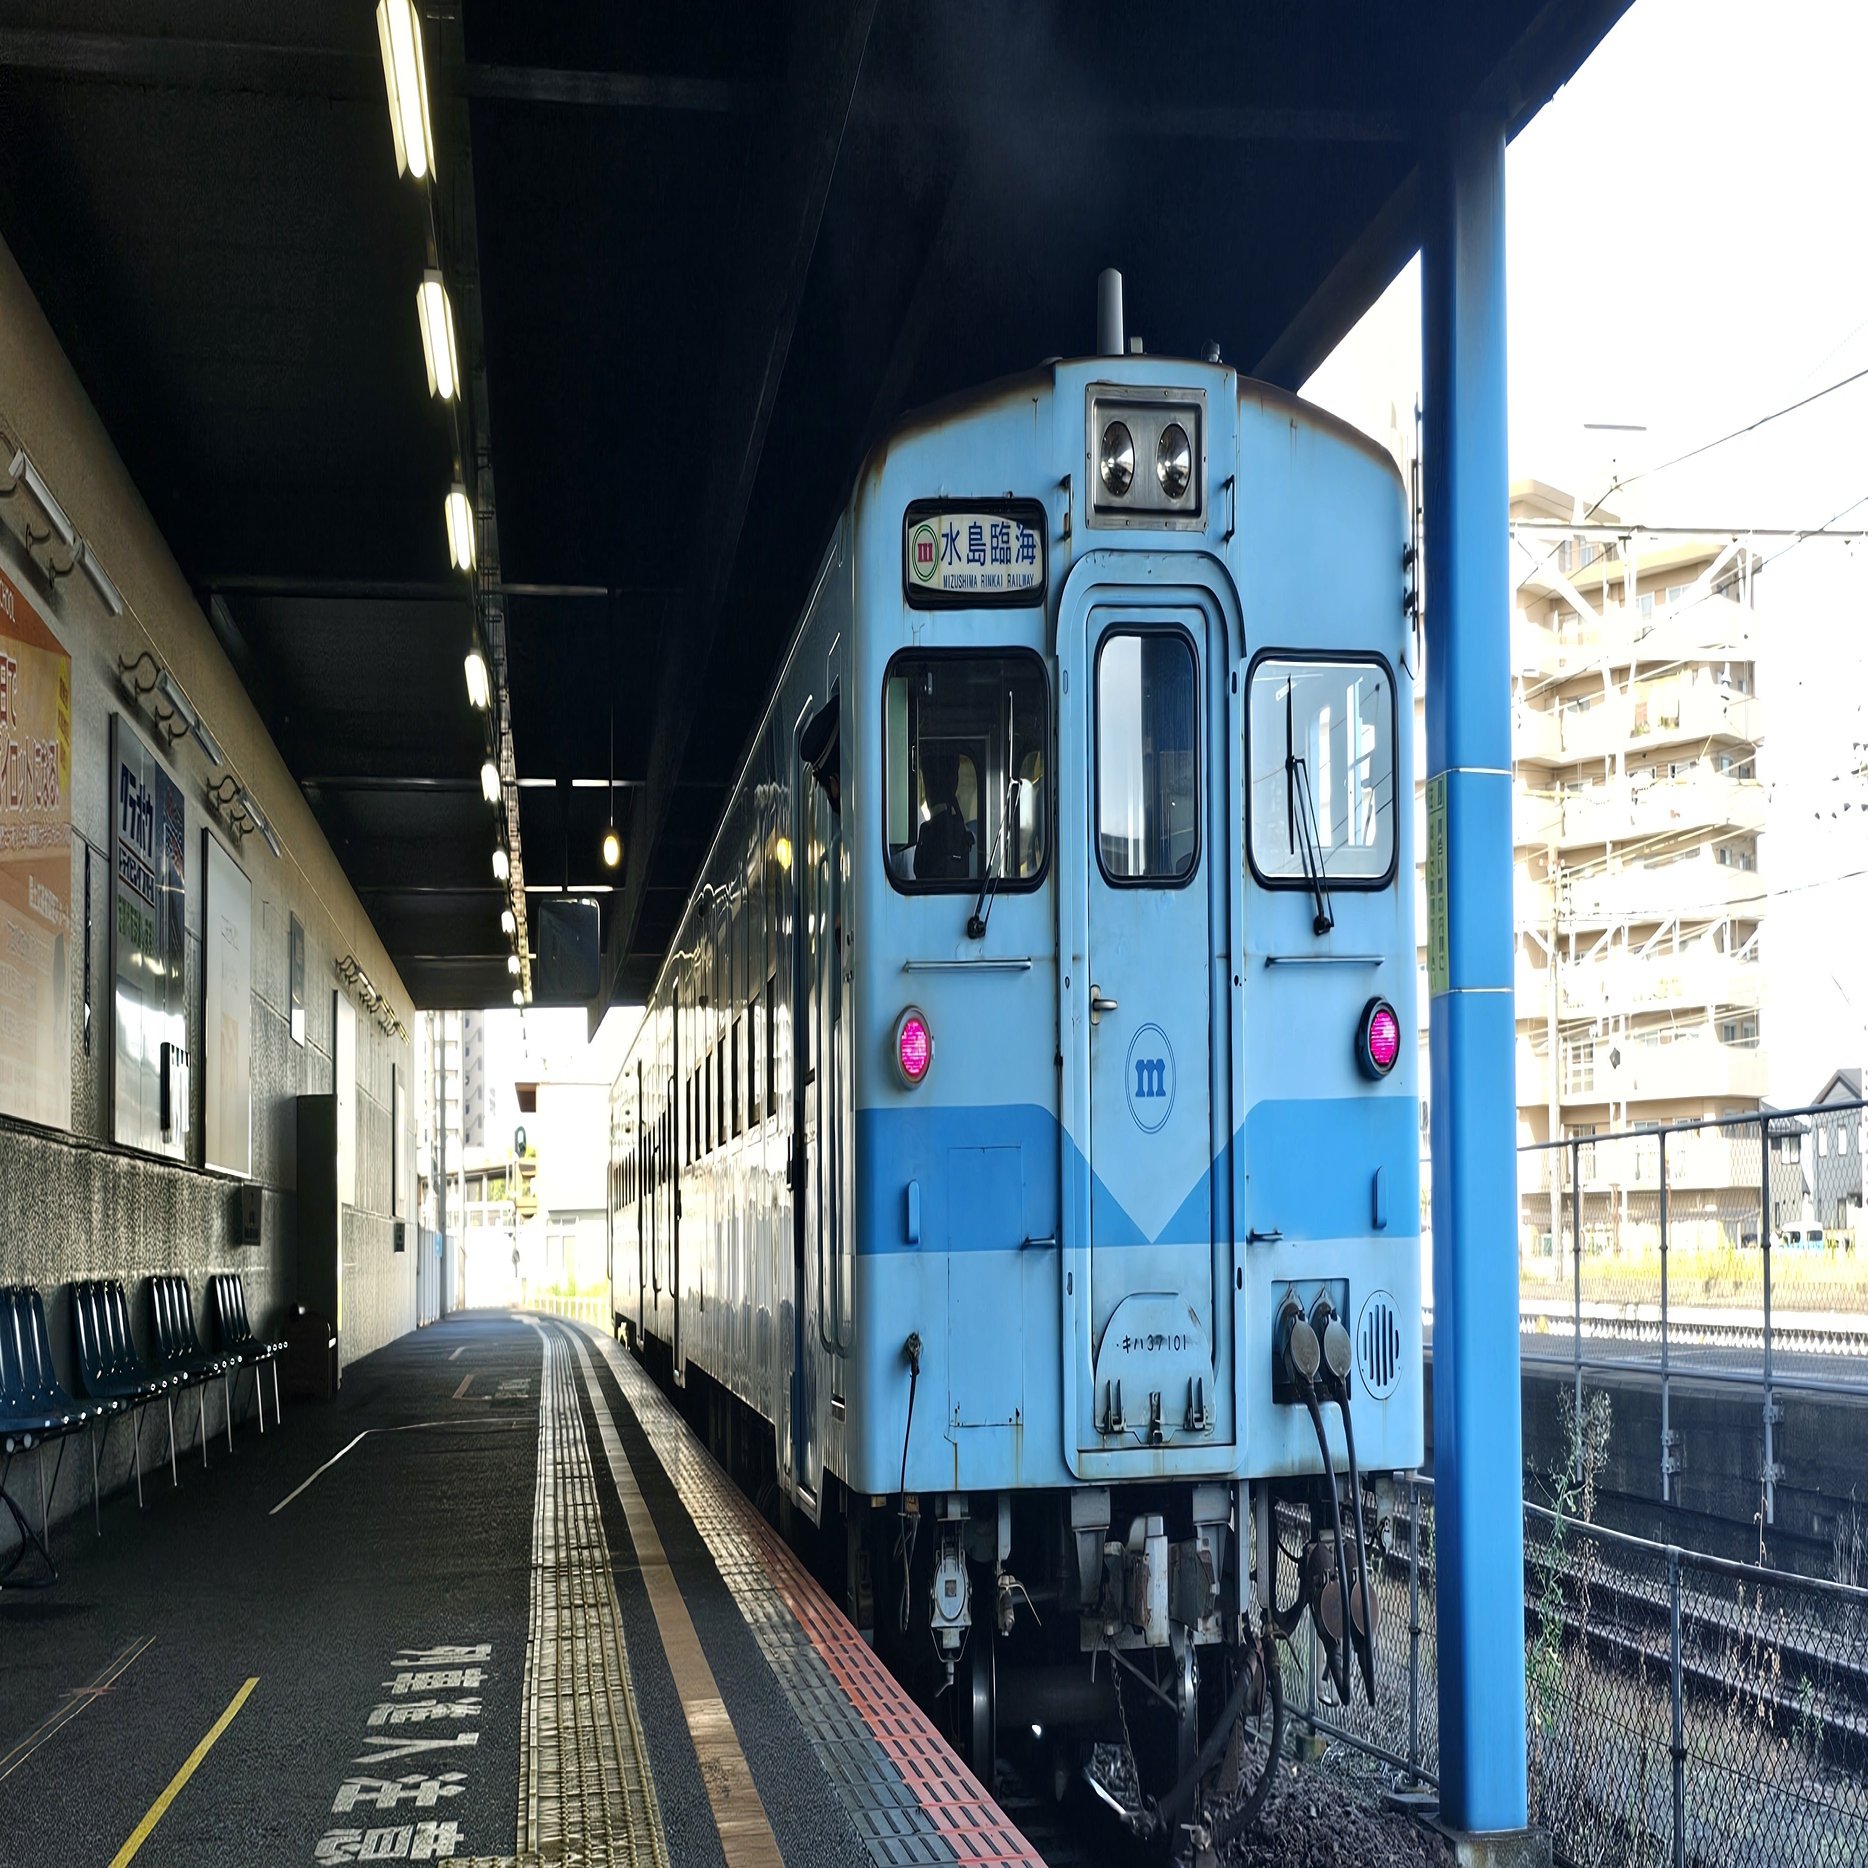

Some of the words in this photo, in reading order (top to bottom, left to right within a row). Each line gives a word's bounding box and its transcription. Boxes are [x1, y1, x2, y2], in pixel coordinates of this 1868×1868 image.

[940, 520, 1037, 567] 水島臨海
[943, 574, 978, 589] MIZUSHIMA
[981, 573, 1003, 589] RINKAI
[1007, 572, 1035, 588] RAILWAY
[120, 761, 154, 858] クラボウ
